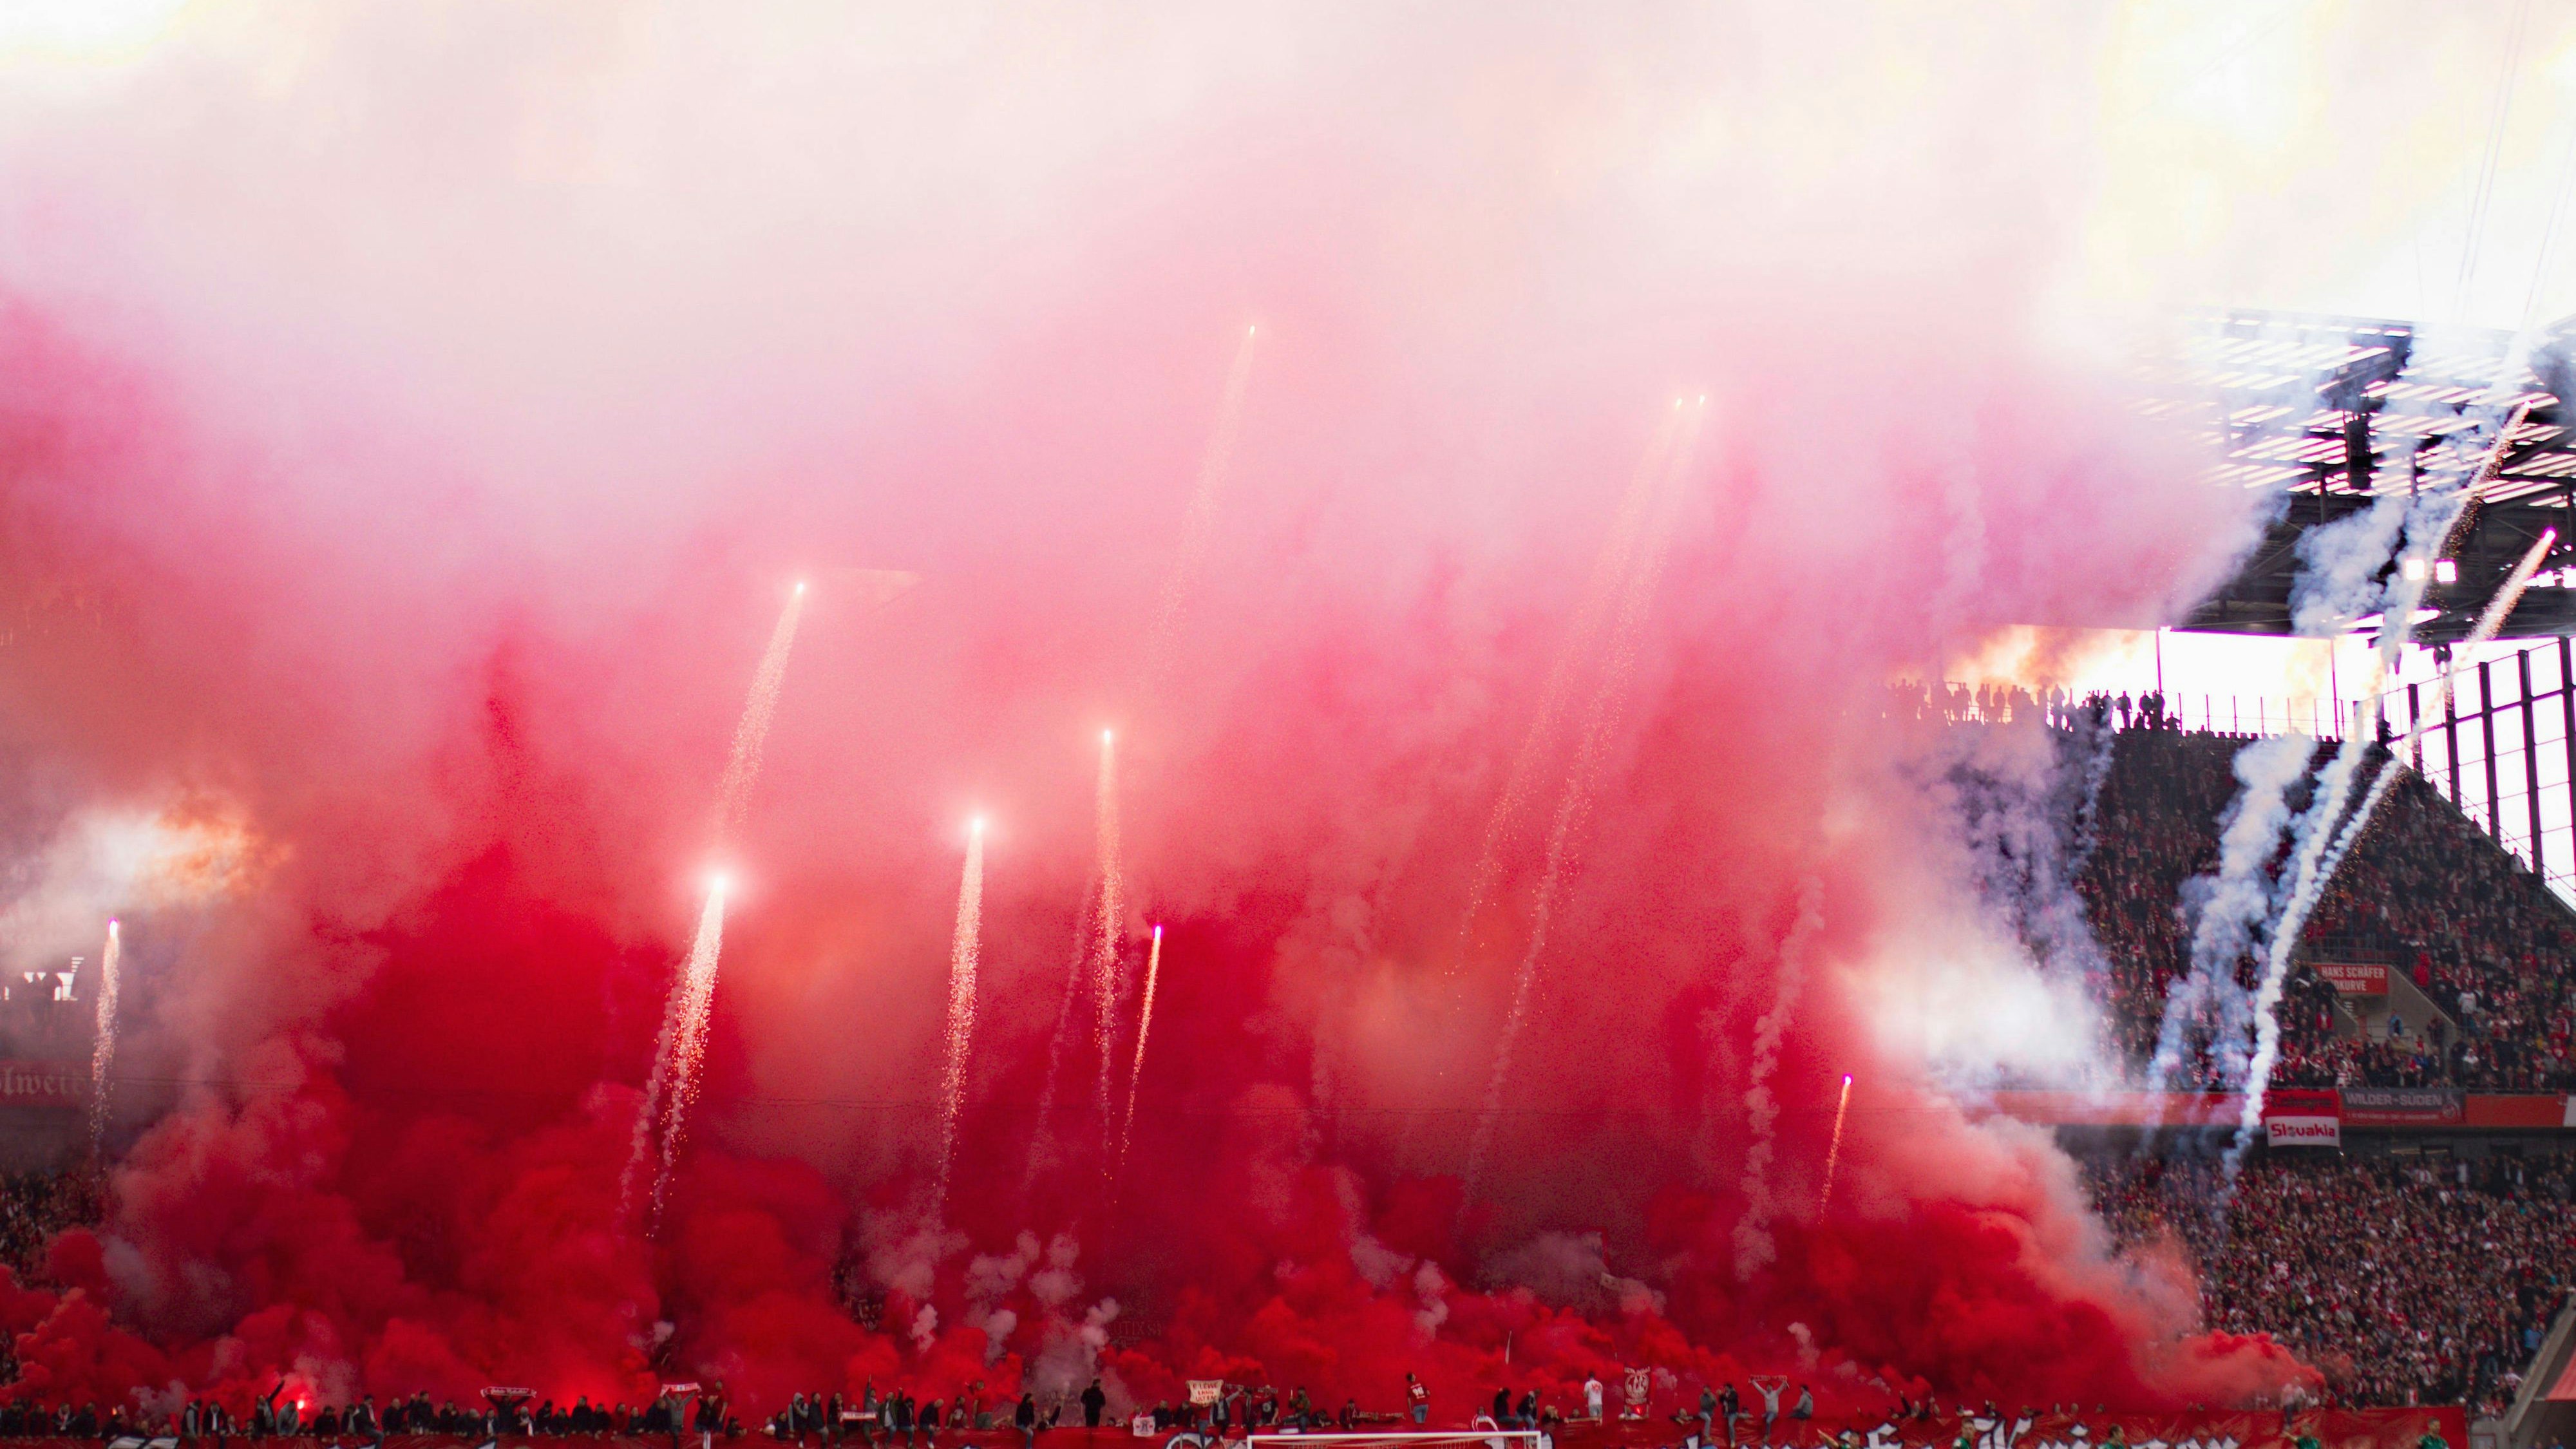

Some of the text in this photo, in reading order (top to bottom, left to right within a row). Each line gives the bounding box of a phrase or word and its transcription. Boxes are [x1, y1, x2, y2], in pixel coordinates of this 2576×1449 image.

[2321, 965, 2385, 979] HANS SCHÄFER
[2331, 979, 2367, 991] DKURVE
[2271, 1122, 2336, 1138] Slovakia
